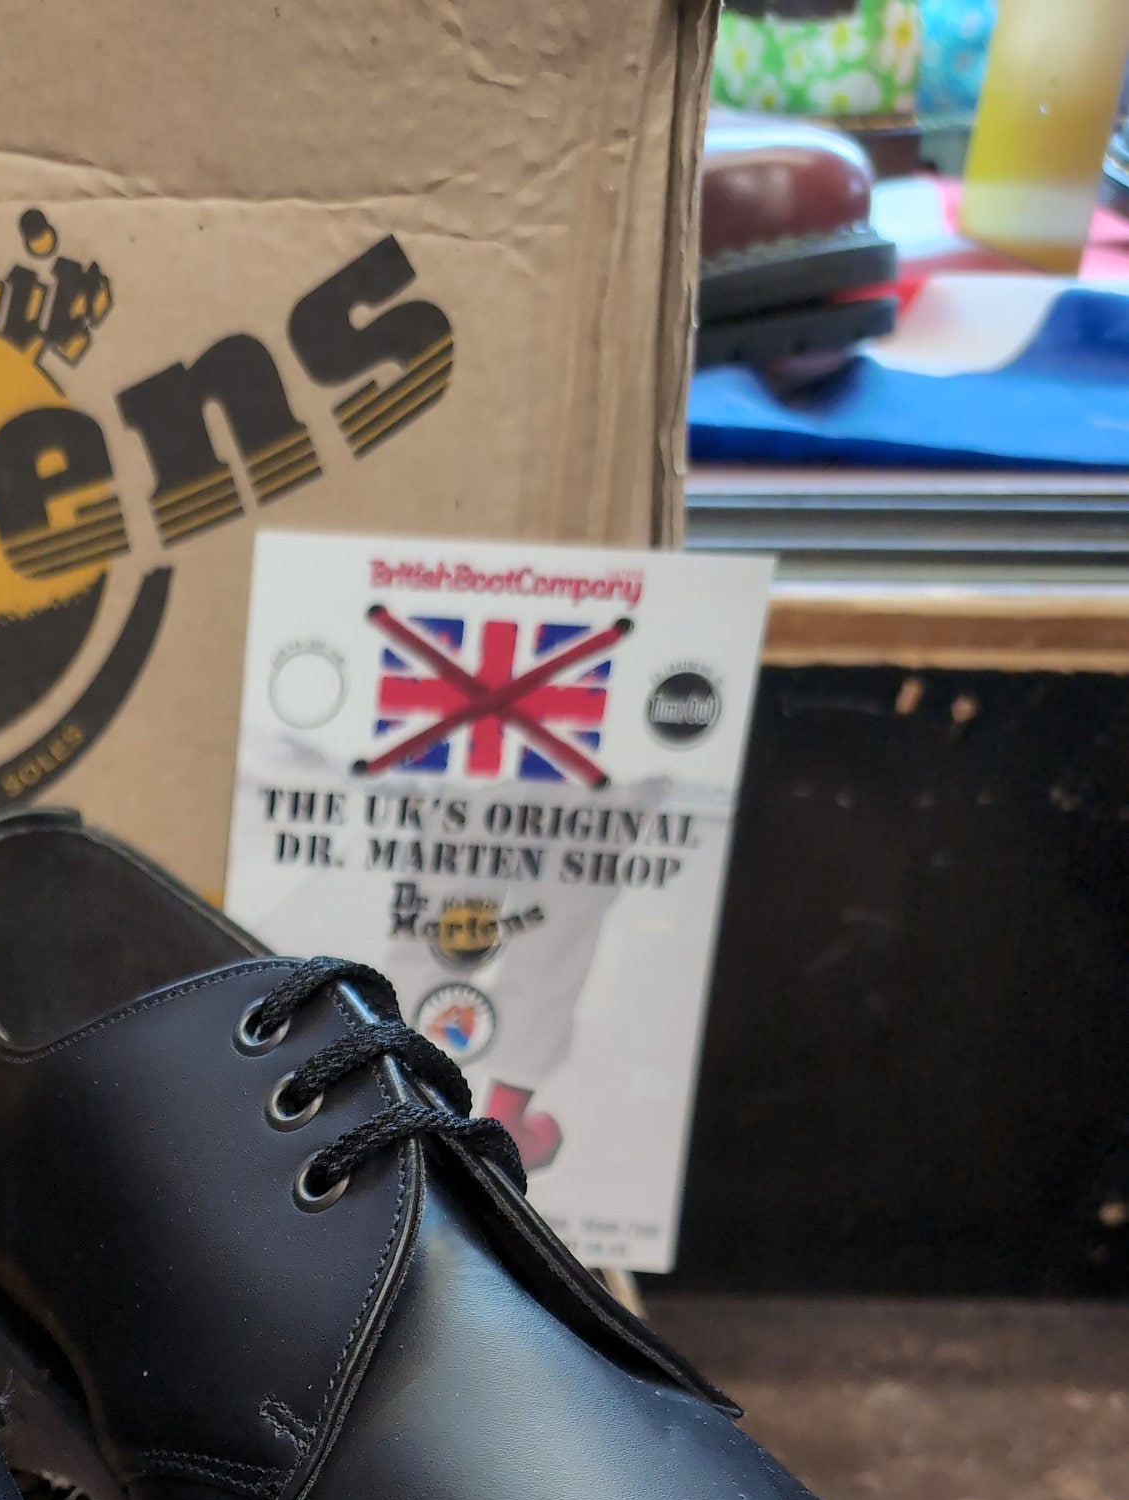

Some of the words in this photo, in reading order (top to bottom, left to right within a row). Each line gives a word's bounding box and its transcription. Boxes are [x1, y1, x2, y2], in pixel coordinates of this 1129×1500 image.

[262, 786, 346, 825] THE
[365, 793, 468, 834] UK'S
[484, 799, 699, 849] ORIGINAL
[274, 830, 344, 869] DR.
[365, 836, 545, 881] MARTEN
[561, 851, 682, 890] SHOP
